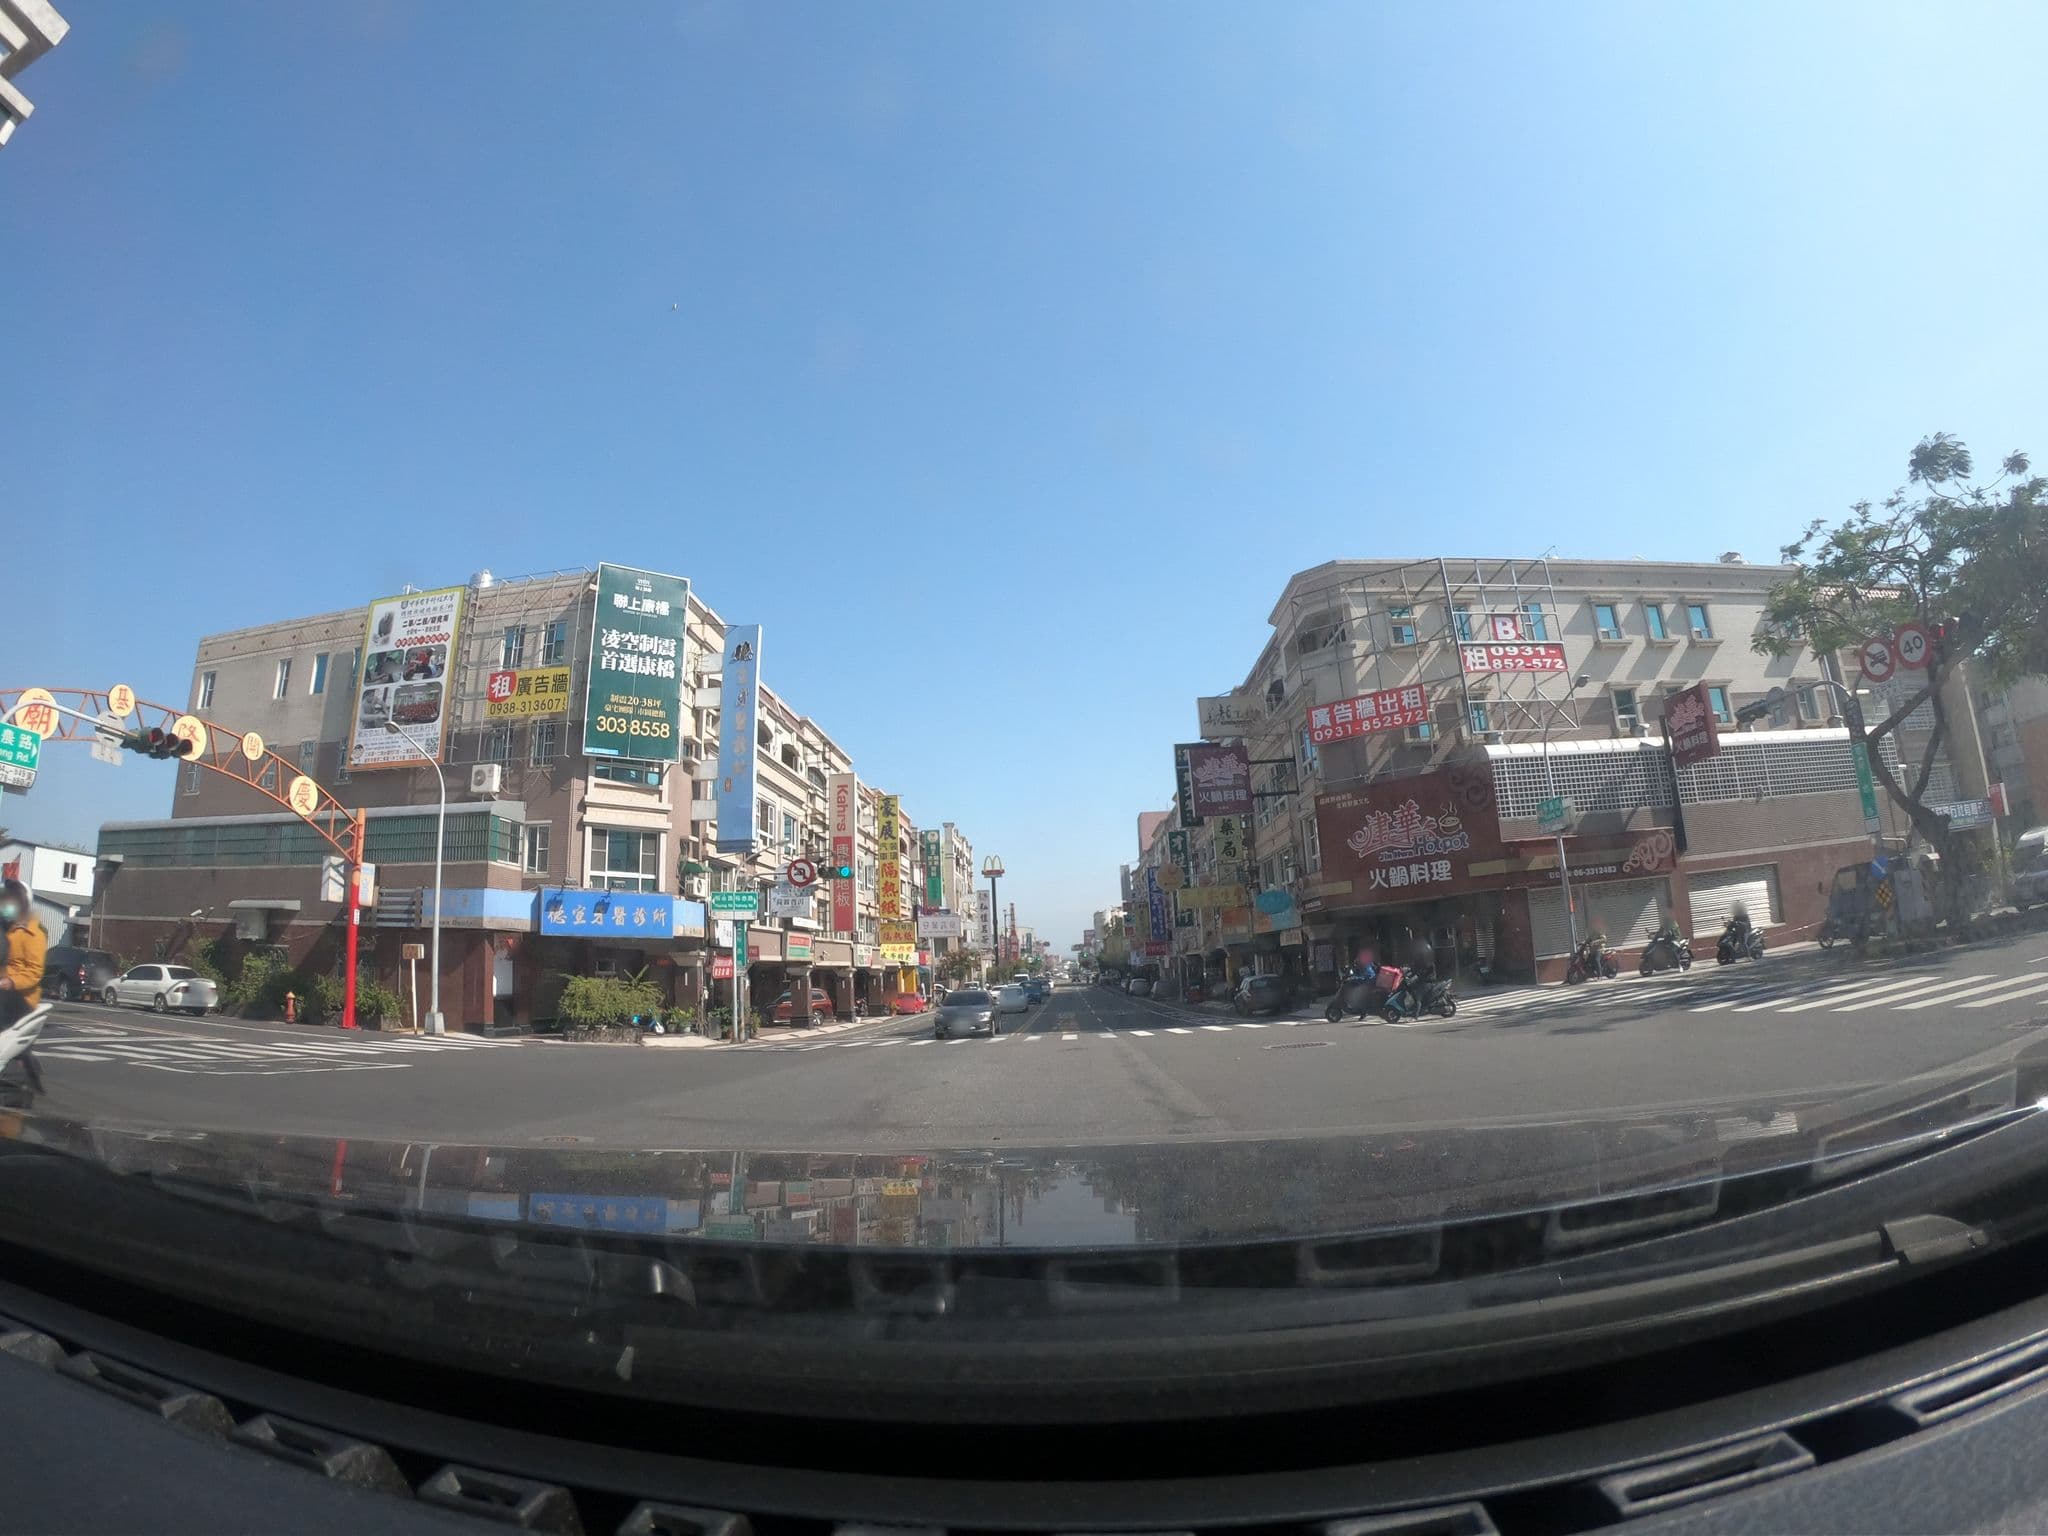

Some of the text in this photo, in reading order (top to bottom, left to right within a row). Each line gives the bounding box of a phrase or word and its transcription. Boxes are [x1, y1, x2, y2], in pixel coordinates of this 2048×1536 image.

[1495, 616, 1517, 640] B
[601, 628, 677, 659] 凌空制震
[1463, 645, 1557, 671] 租 0931-
[1903, 635, 1923, 654] 40
[600, 650, 676, 680] 首選康橋
[1491, 658, 1565, 670] 852-572
[491, 672, 569, 699] 租 廣告牆
[489, 698, 561, 715] 0938-313607
[1311, 687, 1423, 729] 廣告牆出租
[596, 715, 671, 739] 303-8558
[1313, 710, 1425, 741] 0931-852572
[880, 797, 897, 840] 豪展
[1219, 818, 1237, 858] 藥局
[881, 861, 899, 916] 隔熱紙
[1369, 859, 1453, 890] 火鍋料理
